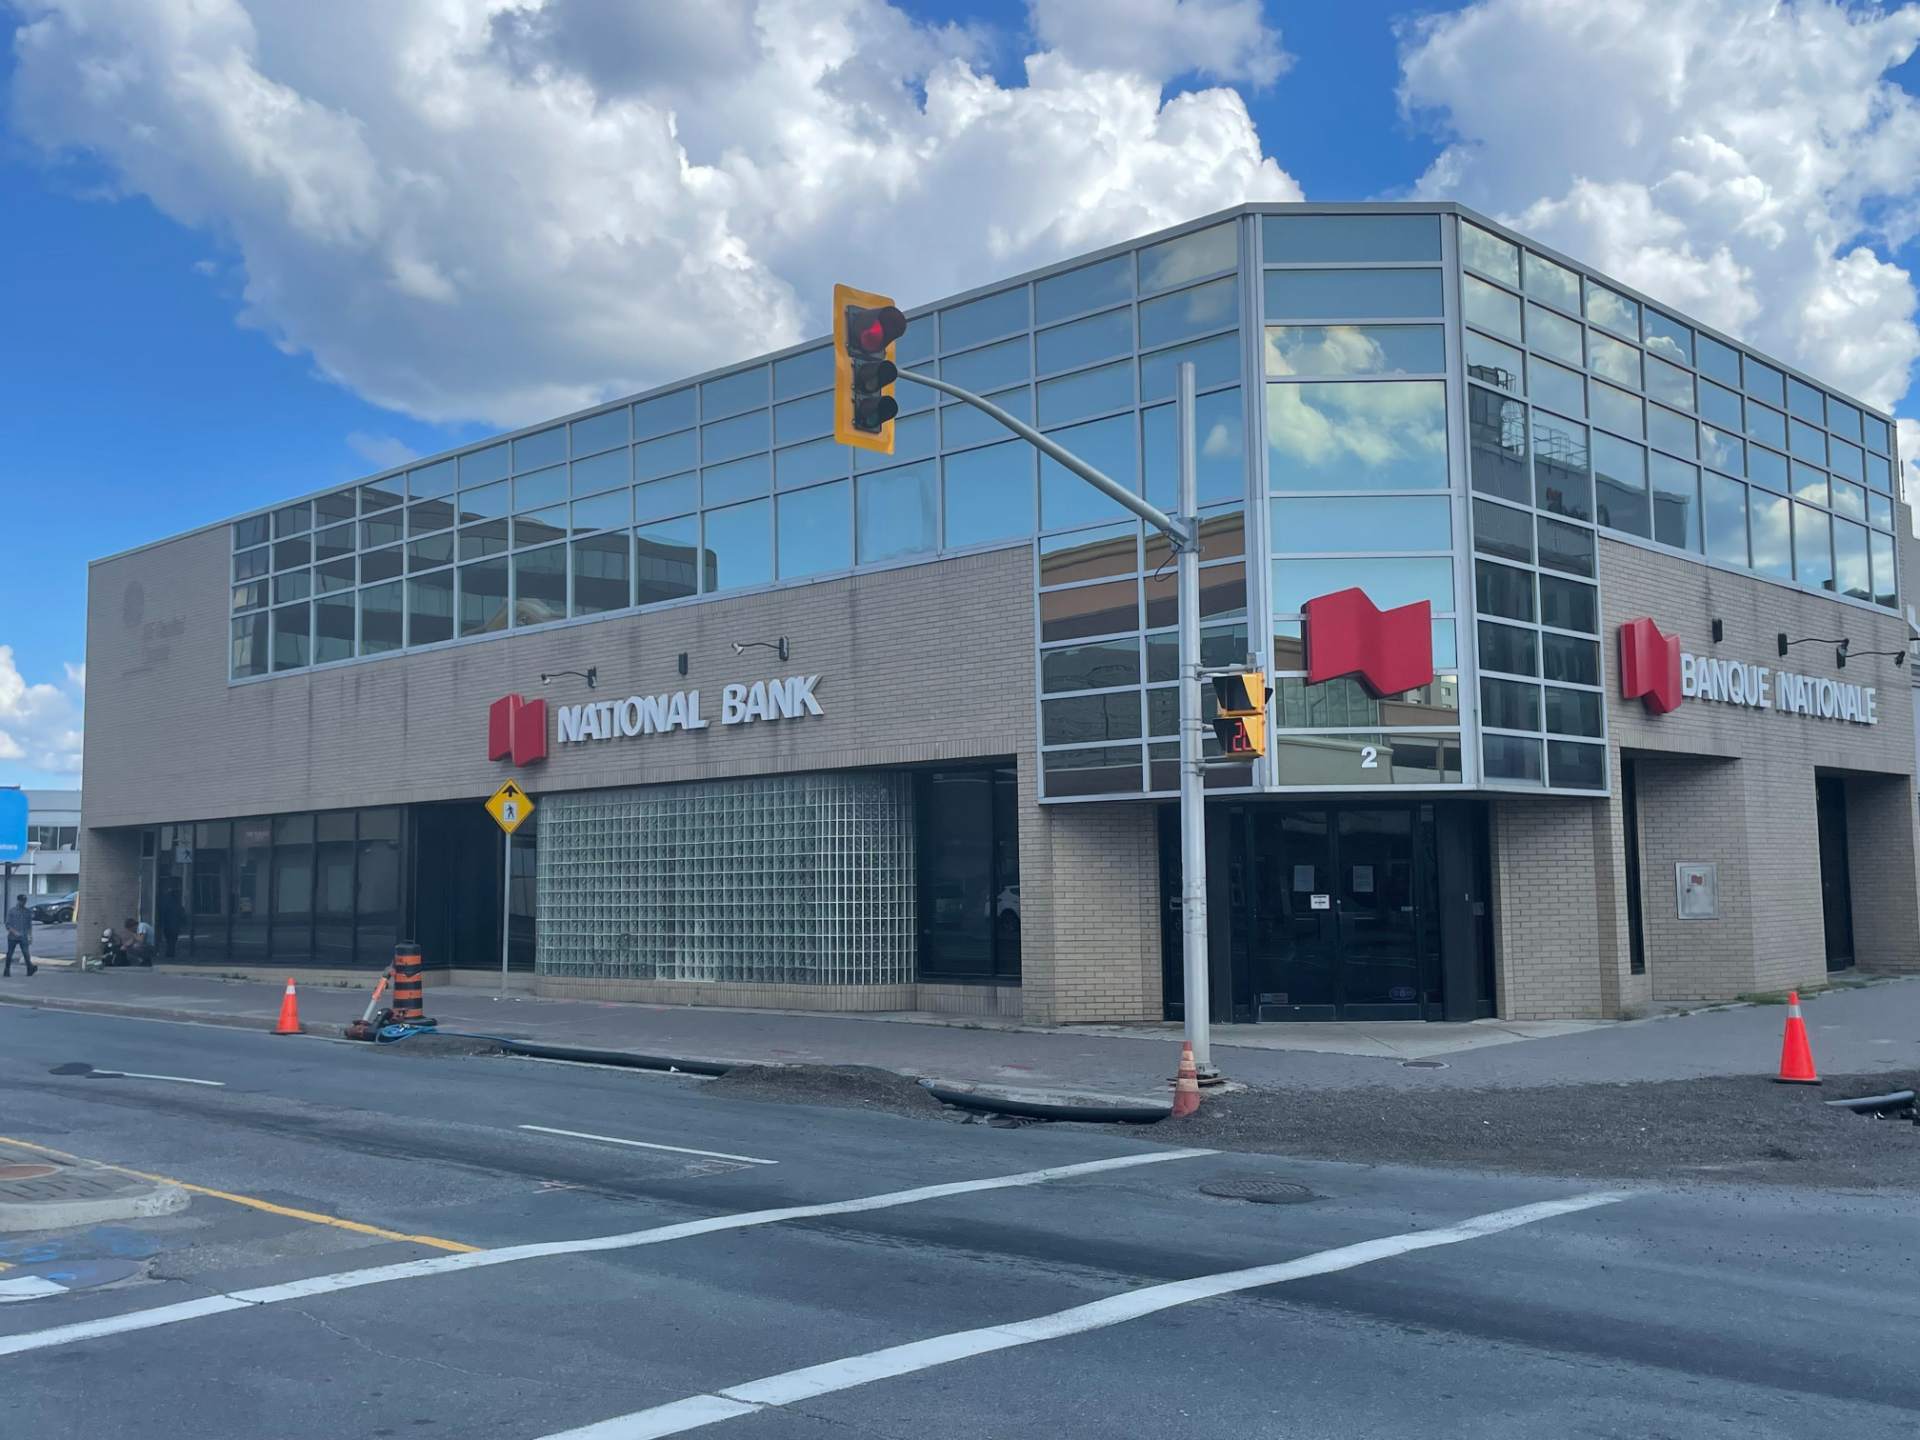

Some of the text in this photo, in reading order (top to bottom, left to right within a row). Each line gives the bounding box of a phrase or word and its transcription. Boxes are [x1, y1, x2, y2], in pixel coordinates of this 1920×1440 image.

[558, 674, 824, 743] NATIONAL BANK
[1681, 653, 1878, 725] BANQUE NATIONALE
[1361, 746, 1378, 768] 2
